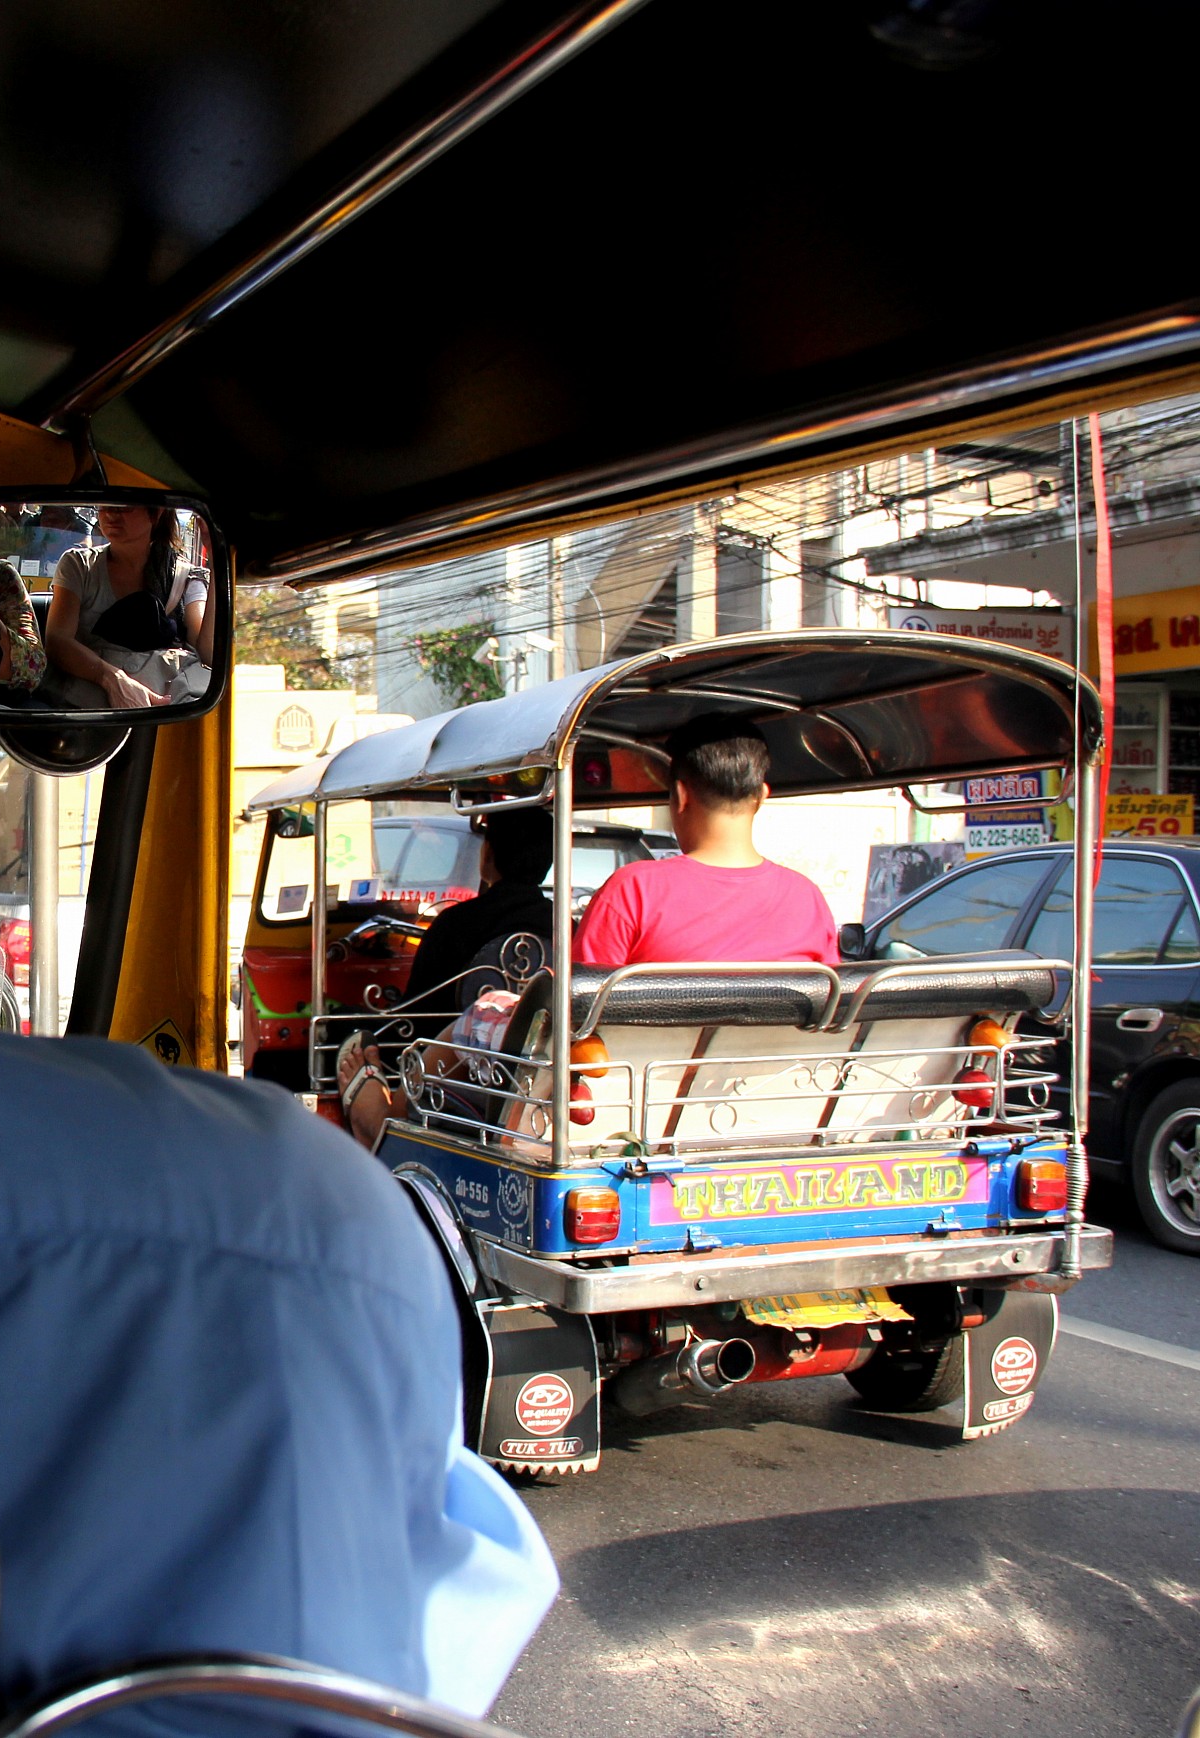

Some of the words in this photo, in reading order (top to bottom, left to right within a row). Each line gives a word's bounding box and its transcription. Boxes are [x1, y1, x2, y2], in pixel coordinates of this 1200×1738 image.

[967, 774, 1039, 803] ผูผลิต
[674, 1160, 968, 1218] THAILAND
